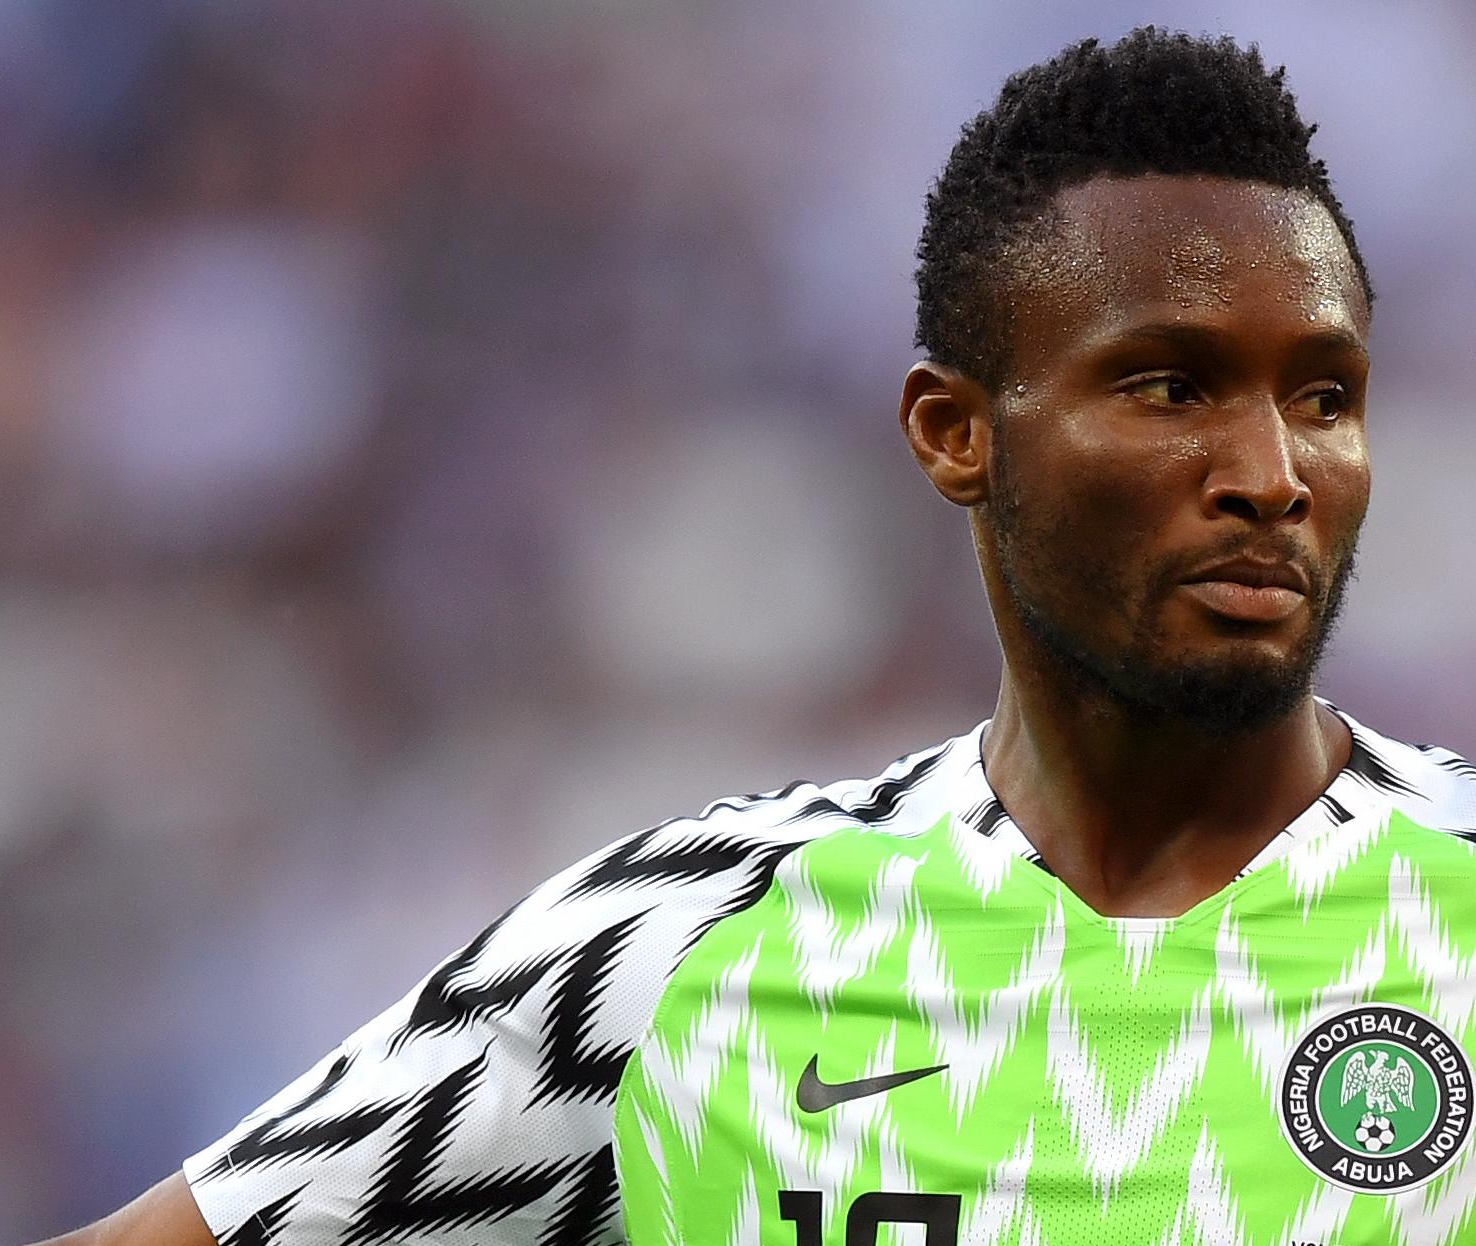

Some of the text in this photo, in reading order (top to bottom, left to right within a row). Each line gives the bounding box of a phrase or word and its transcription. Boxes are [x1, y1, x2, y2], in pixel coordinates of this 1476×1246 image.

[1289, 1014, 1467, 1164] NIGERIA FOOTBALL FEDERATION
[1331, 1156, 1414, 1183] ABUJA
